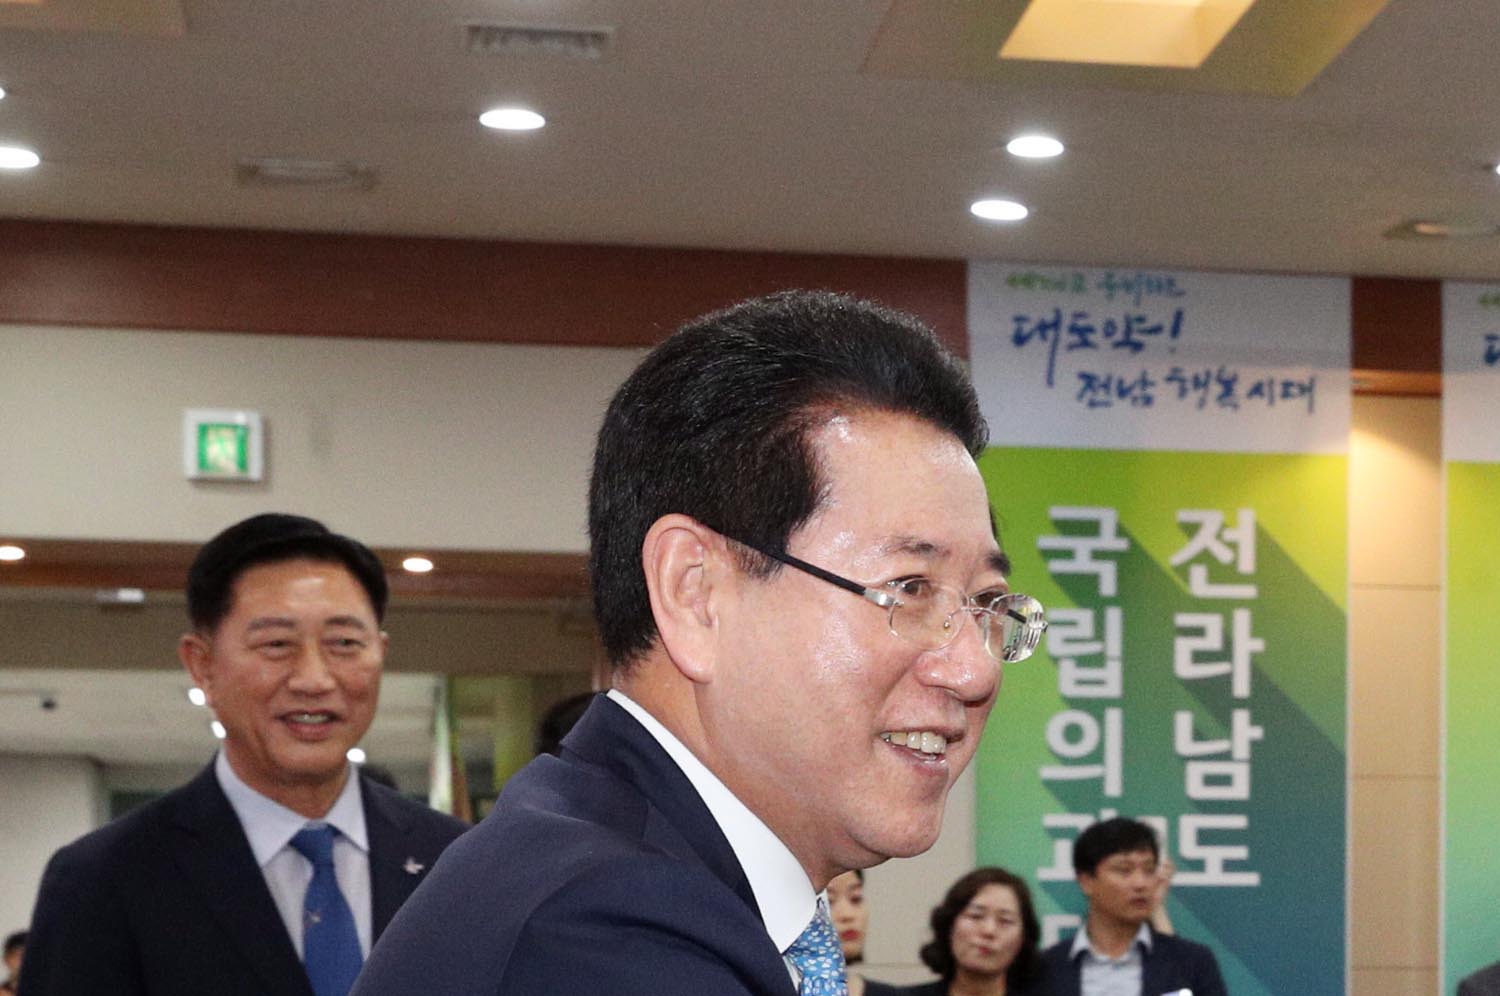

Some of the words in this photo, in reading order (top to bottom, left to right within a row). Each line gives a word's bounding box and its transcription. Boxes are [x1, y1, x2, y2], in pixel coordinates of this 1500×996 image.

[1011, 307, 1185, 388] 대도약!
[1076, 367, 1156, 409] 전남
[1168, 507, 1266, 887] 전라남도
